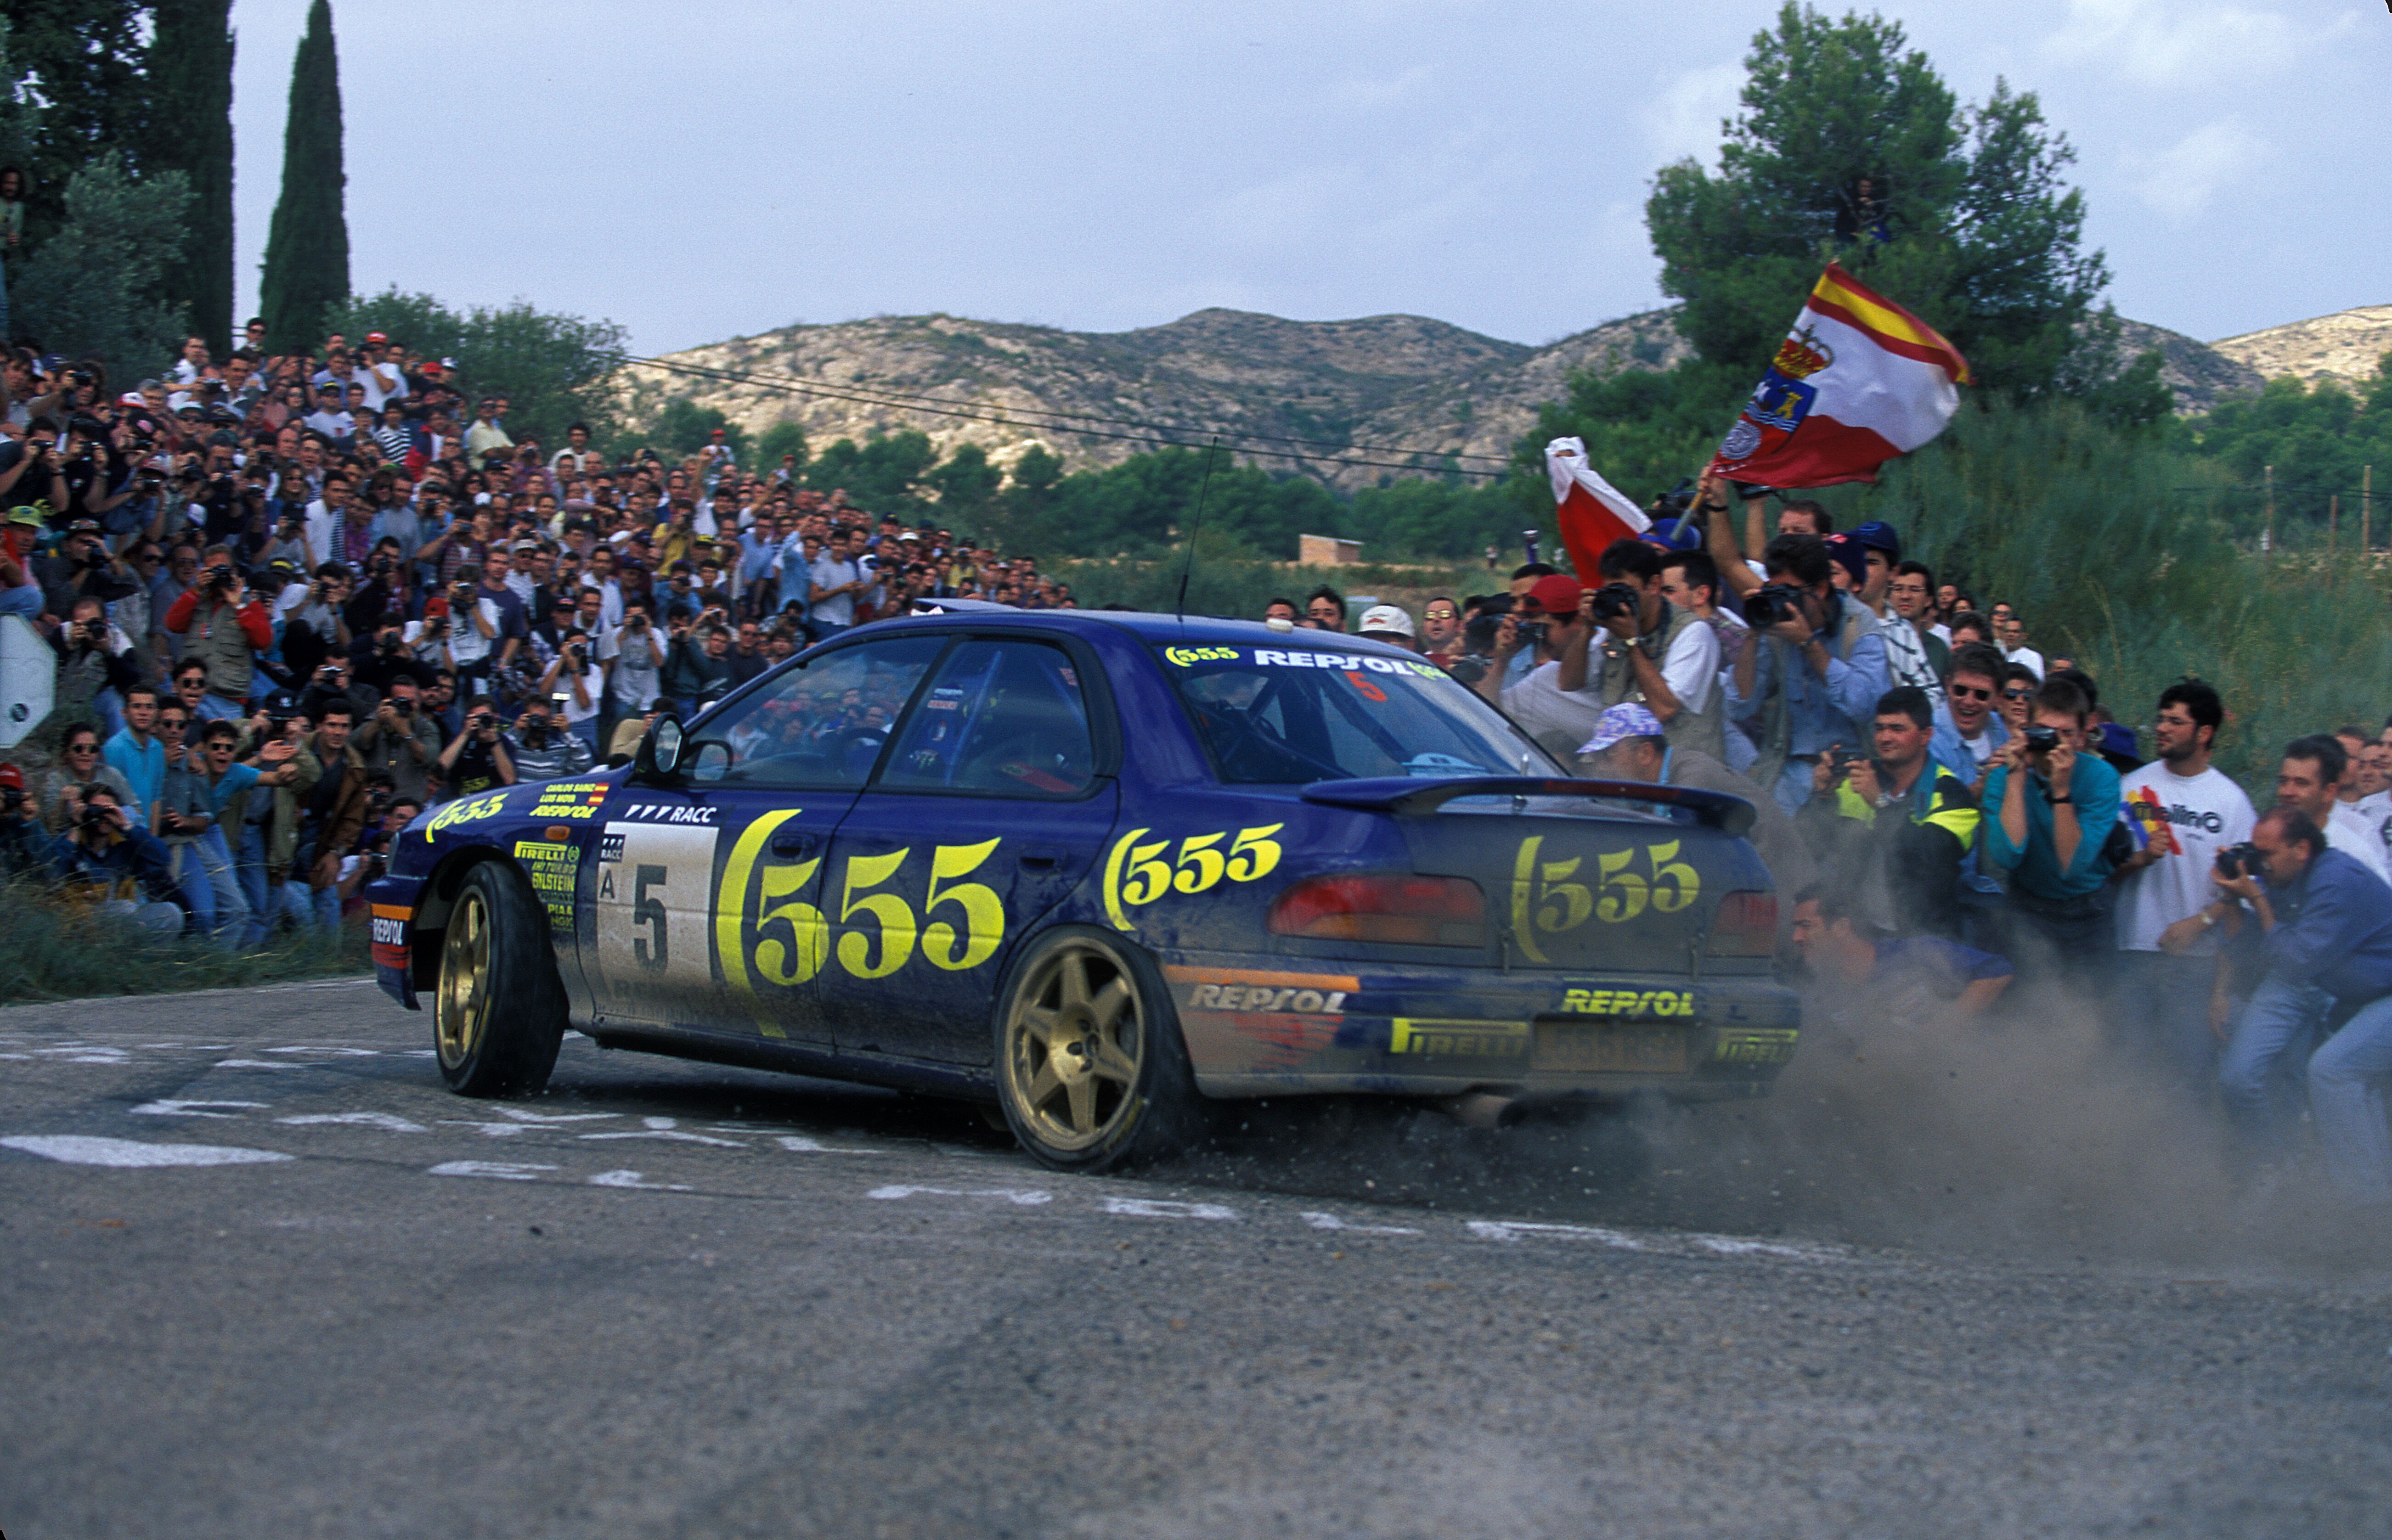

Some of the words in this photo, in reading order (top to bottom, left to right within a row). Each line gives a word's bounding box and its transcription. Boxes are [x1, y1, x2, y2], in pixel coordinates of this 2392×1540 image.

[1254, 650, 1415, 675] REPSOL
[1345, 670, 1387, 702] 5
[529, 805, 597, 818] REPSOL
[669, 807, 716, 823] RACC
[514, 841, 567, 861] PIRELLI
[601, 849, 622, 860] RACC
[532, 872, 574, 892] BILSTEIN
[599, 869, 615, 899] A
[548, 904, 574, 915] PIAA
[634, 864, 668, 976] 5
[373, 918, 403, 945] REPSOL
[1190, 984, 1346, 1013] REPSOL
[1561, 989, 1694, 1017] REPSOL
